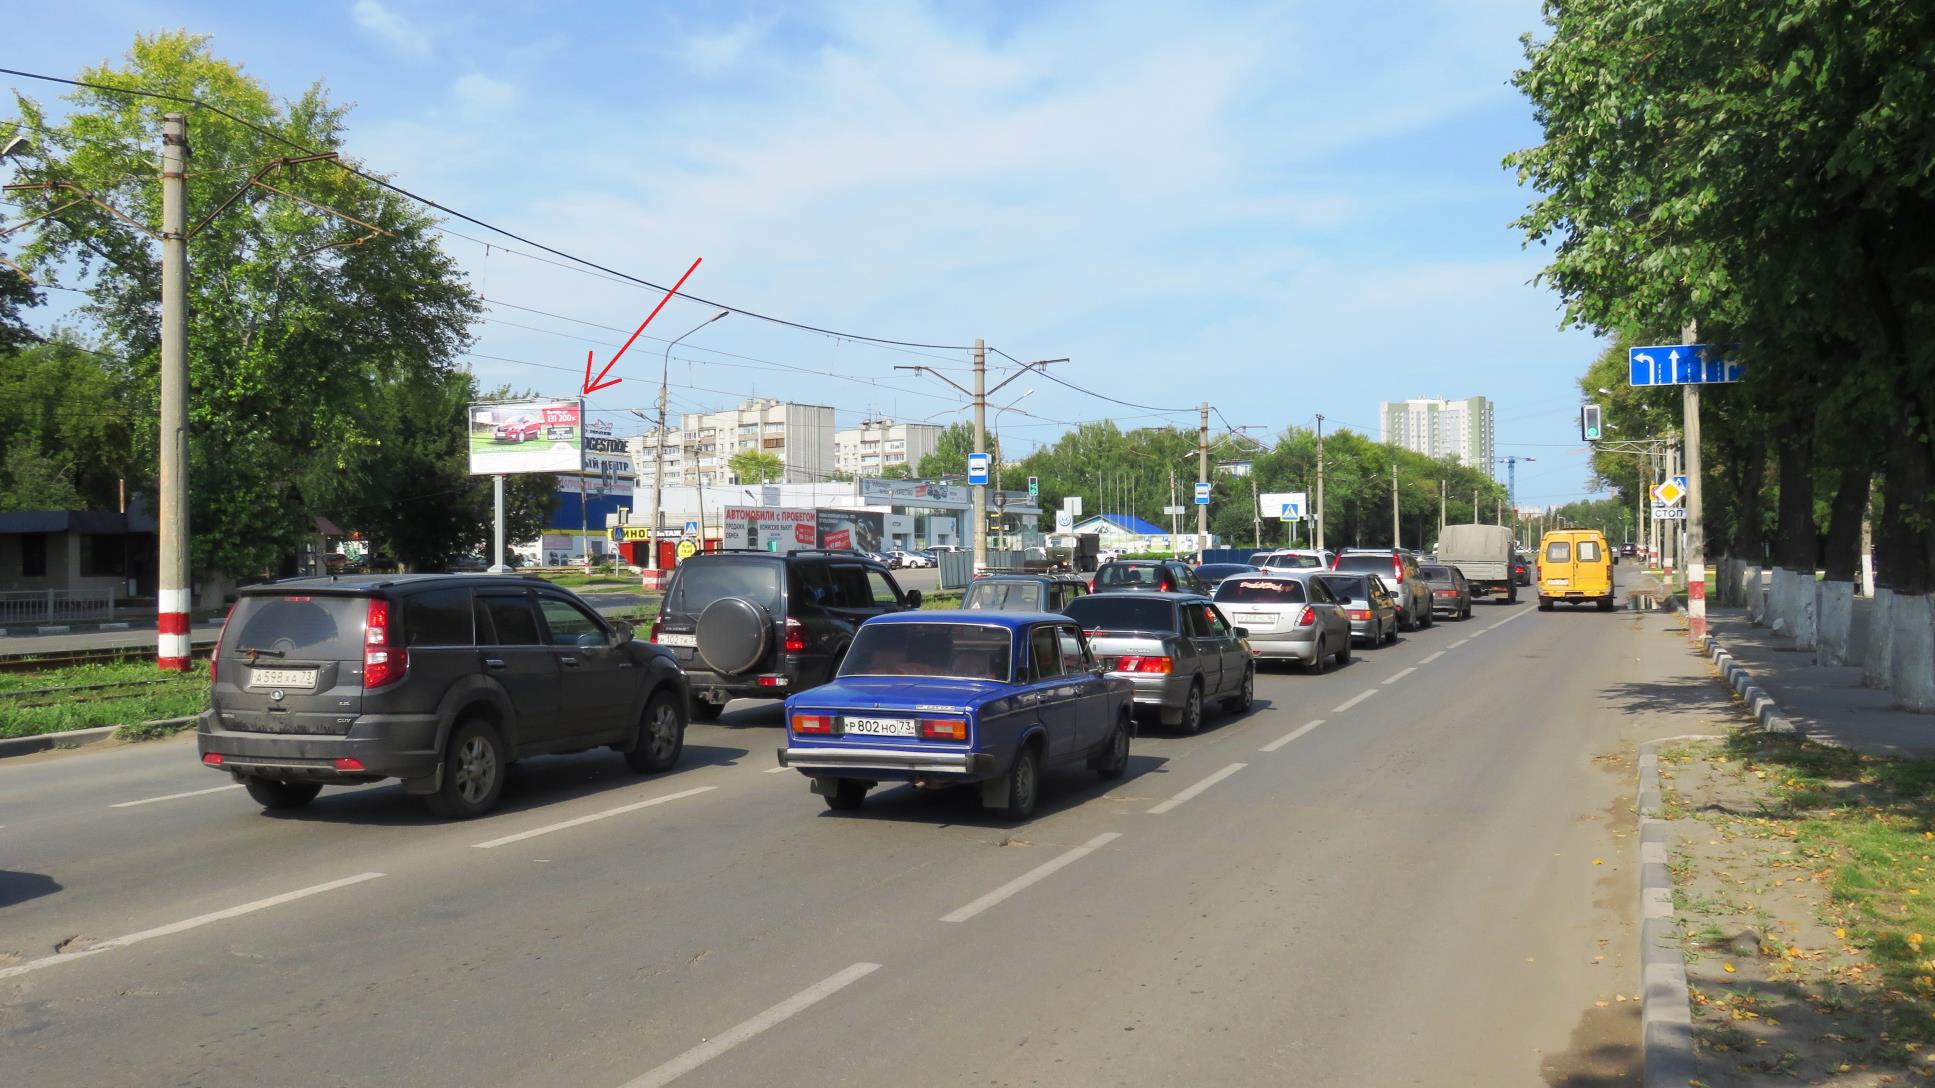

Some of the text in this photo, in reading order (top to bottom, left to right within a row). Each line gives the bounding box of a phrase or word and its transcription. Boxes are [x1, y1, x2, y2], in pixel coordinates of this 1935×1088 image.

[726, 510, 775, 521] АВТОМОБИЛИ
[782, 511, 815, 521] ПРОБЕГОМ
[849, 720, 897, 734] Р802НО
[898, 721, 911, 731] 73
